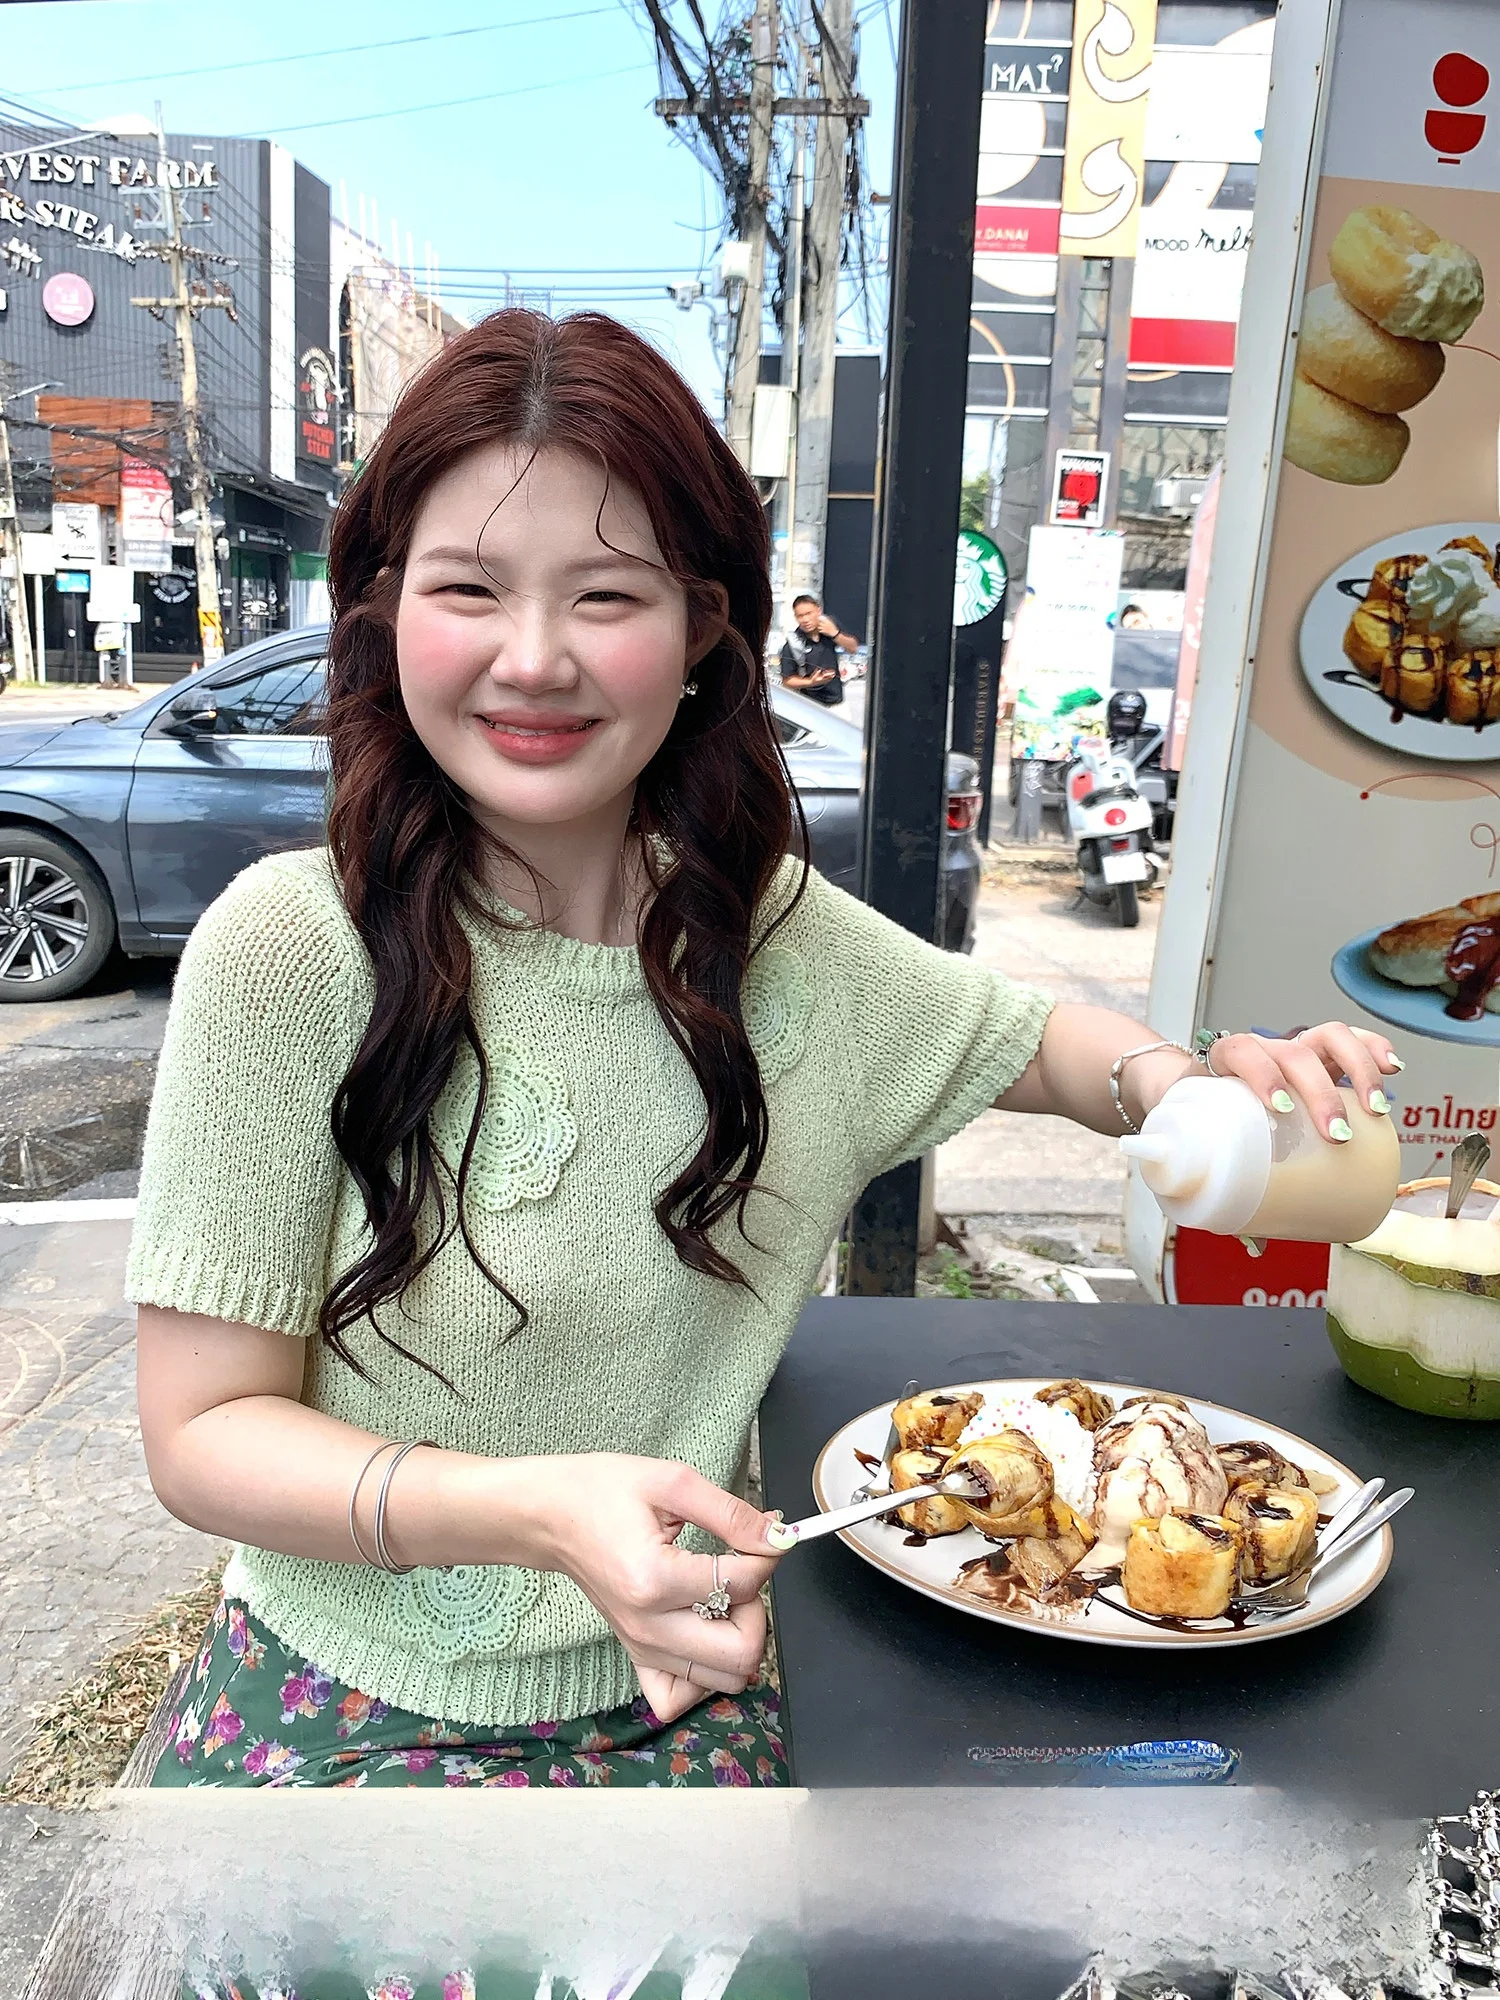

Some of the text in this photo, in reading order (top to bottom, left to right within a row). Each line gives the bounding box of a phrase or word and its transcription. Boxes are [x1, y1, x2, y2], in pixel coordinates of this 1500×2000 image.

[109, 156, 219, 189] FARM
[1145, 238, 1189, 251] MOOD
[1403, 1095, 1497, 1130] ชาไทย
[1398, 1133, 1426, 1144] LUE
